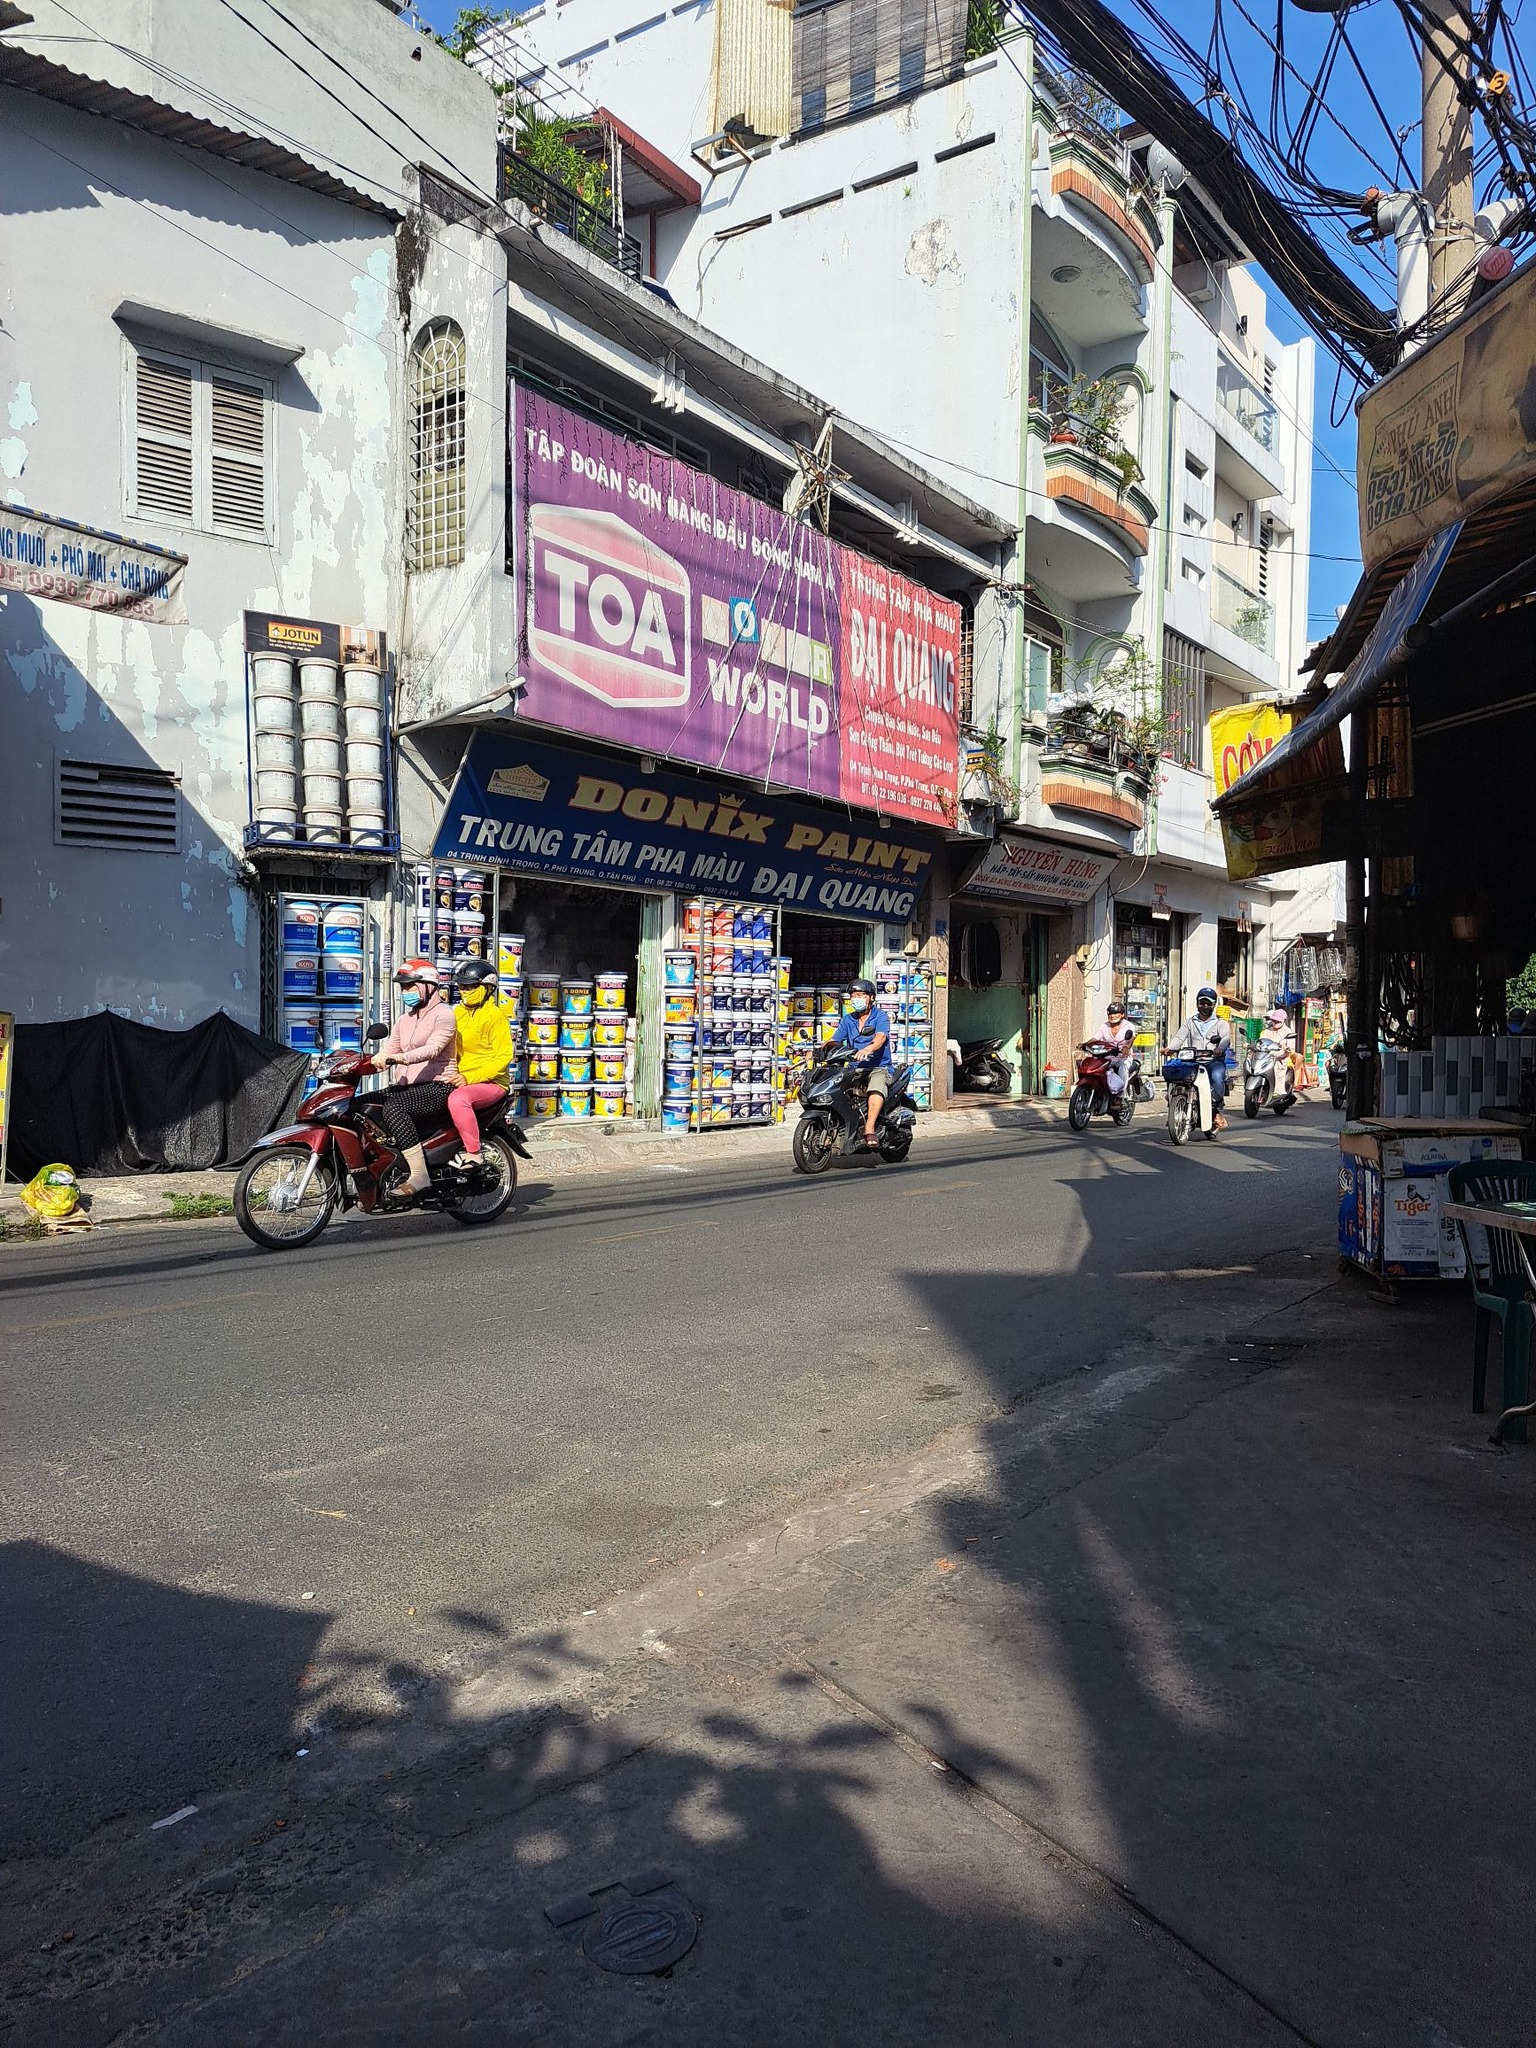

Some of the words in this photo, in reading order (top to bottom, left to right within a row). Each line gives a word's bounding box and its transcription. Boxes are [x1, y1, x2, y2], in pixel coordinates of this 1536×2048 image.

[1423, 385, 1455, 431] ANH
[524, 426, 565, 464] TẬP
[570, 448, 622, 493] ĐOÀN
[627, 478, 662, 512] SƠN
[716, 516, 747, 551] ĐẦU
[1367, 458, 1451, 531] 0919.772.132
[17, 527, 46, 568] MUỐI
[61, 542, 84, 578] PHÔ
[87, 550, 107, 584] MAI
[121, 558, 141, 593] CHÀ
[143, 562, 170, 600] BÔNG
[28, 571, 78, 598] 0936
[84, 584, 119, 607] 770
[123, 595, 155, 617] 853
[543, 552, 676, 667] TOA
[851, 569, 887, 604] TRUNG
[889, 586, 911, 613] TÂM
[914, 599, 933, 625] PHA
[935, 609, 956, 634] MÀU
[283, 628, 319, 642] JOTUN
[851, 608, 887, 698] ĐẠI
[893, 628, 955, 715] QUANG
[707, 657, 829, 735] WORLD
[849, 760, 857, 772] 04
[567, 775, 776, 845] DONIX
[784, 822, 933, 874] PAINT
[879, 787, 886, 798] 22
[887, 789, 896, 803] 196
[910, 796, 922, 808] 0937
[924, 799, 933, 811] 278
[447, 850, 458, 858] 04
[460, 851, 487, 863] TRỊNH
[488, 853, 510, 866] ĐÌNH
[511, 858, 542, 871] TRỌNG,
[544, 862, 568, 874] P.PHÚ
[569, 866, 597, 878] TRUNG,
[657, 877, 665, 886] 08
[665, 879, 673, 887] 22
[674, 880, 685, 889] 196
[685, 882, 696, 890] 036
[704, 886, 718, 894] 0937
[458, 814, 564, 857] TRUNG
[570, 829, 633, 867] TÂM
[634, 844, 686, 875] PHA
[689, 851, 746, 884] MÀU
[751, 866, 814, 904] ĐẠI
[818, 879, 915, 917] QUANG
[1000, 845, 1064, 871] NGUYỄN
[1063, 859, 1102, 879] HƯNG
[1394, 1198, 1432, 1217] Tiger
